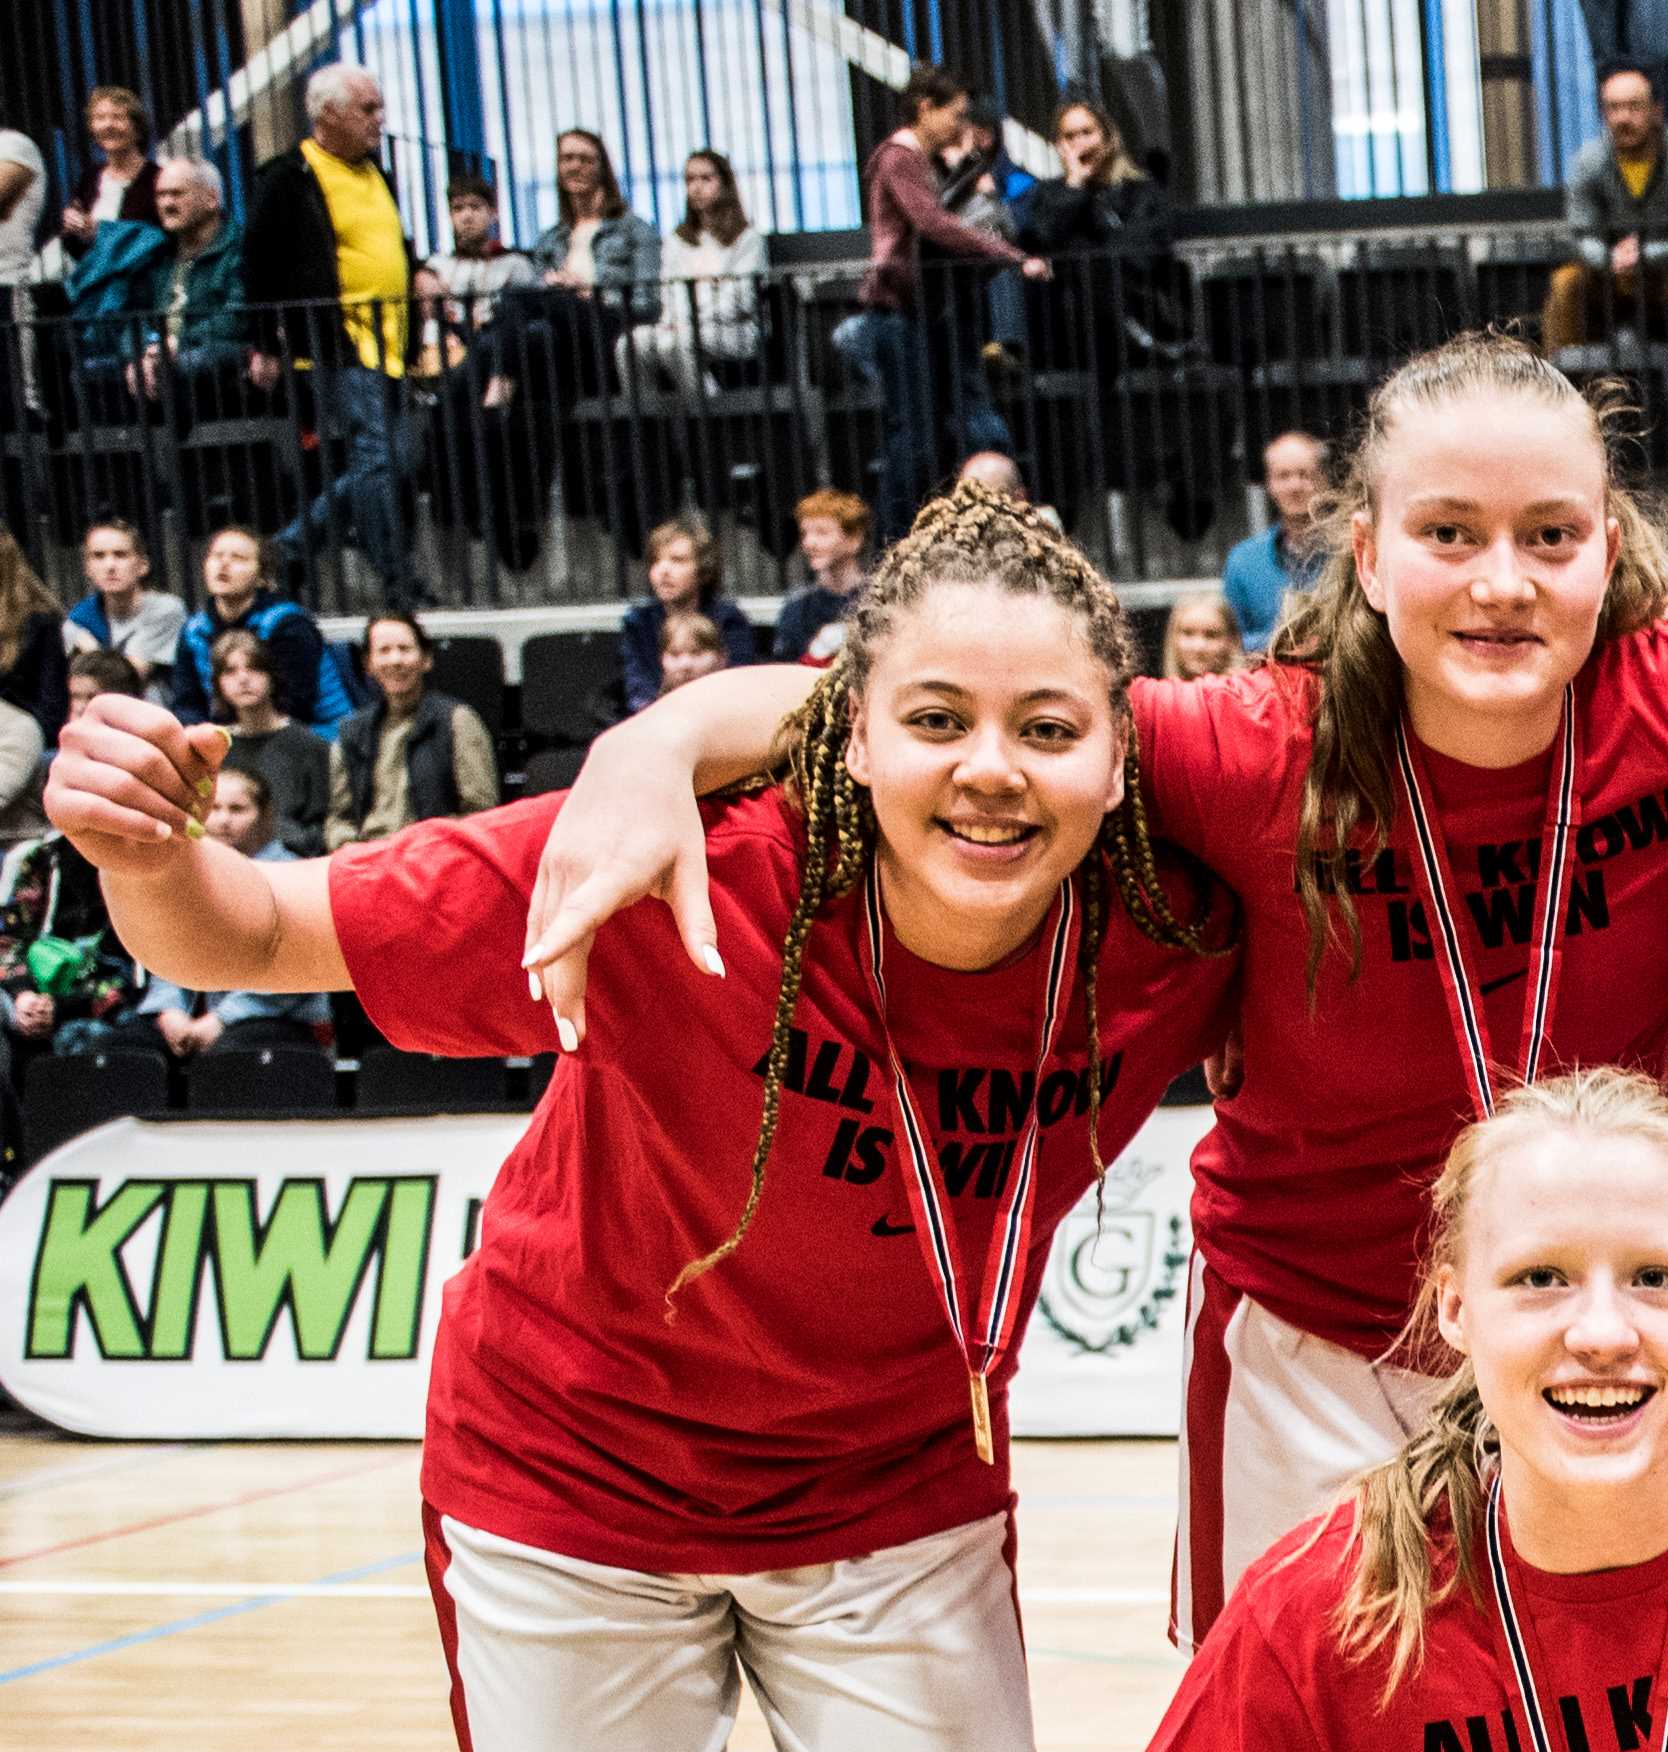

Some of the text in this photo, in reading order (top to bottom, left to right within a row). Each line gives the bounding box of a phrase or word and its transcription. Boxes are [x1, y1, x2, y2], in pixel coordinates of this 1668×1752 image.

[1467, 870, 1610, 948] WN
[822, 1117, 896, 1185] IS
[24, 1173, 439, 1362] KIWI
